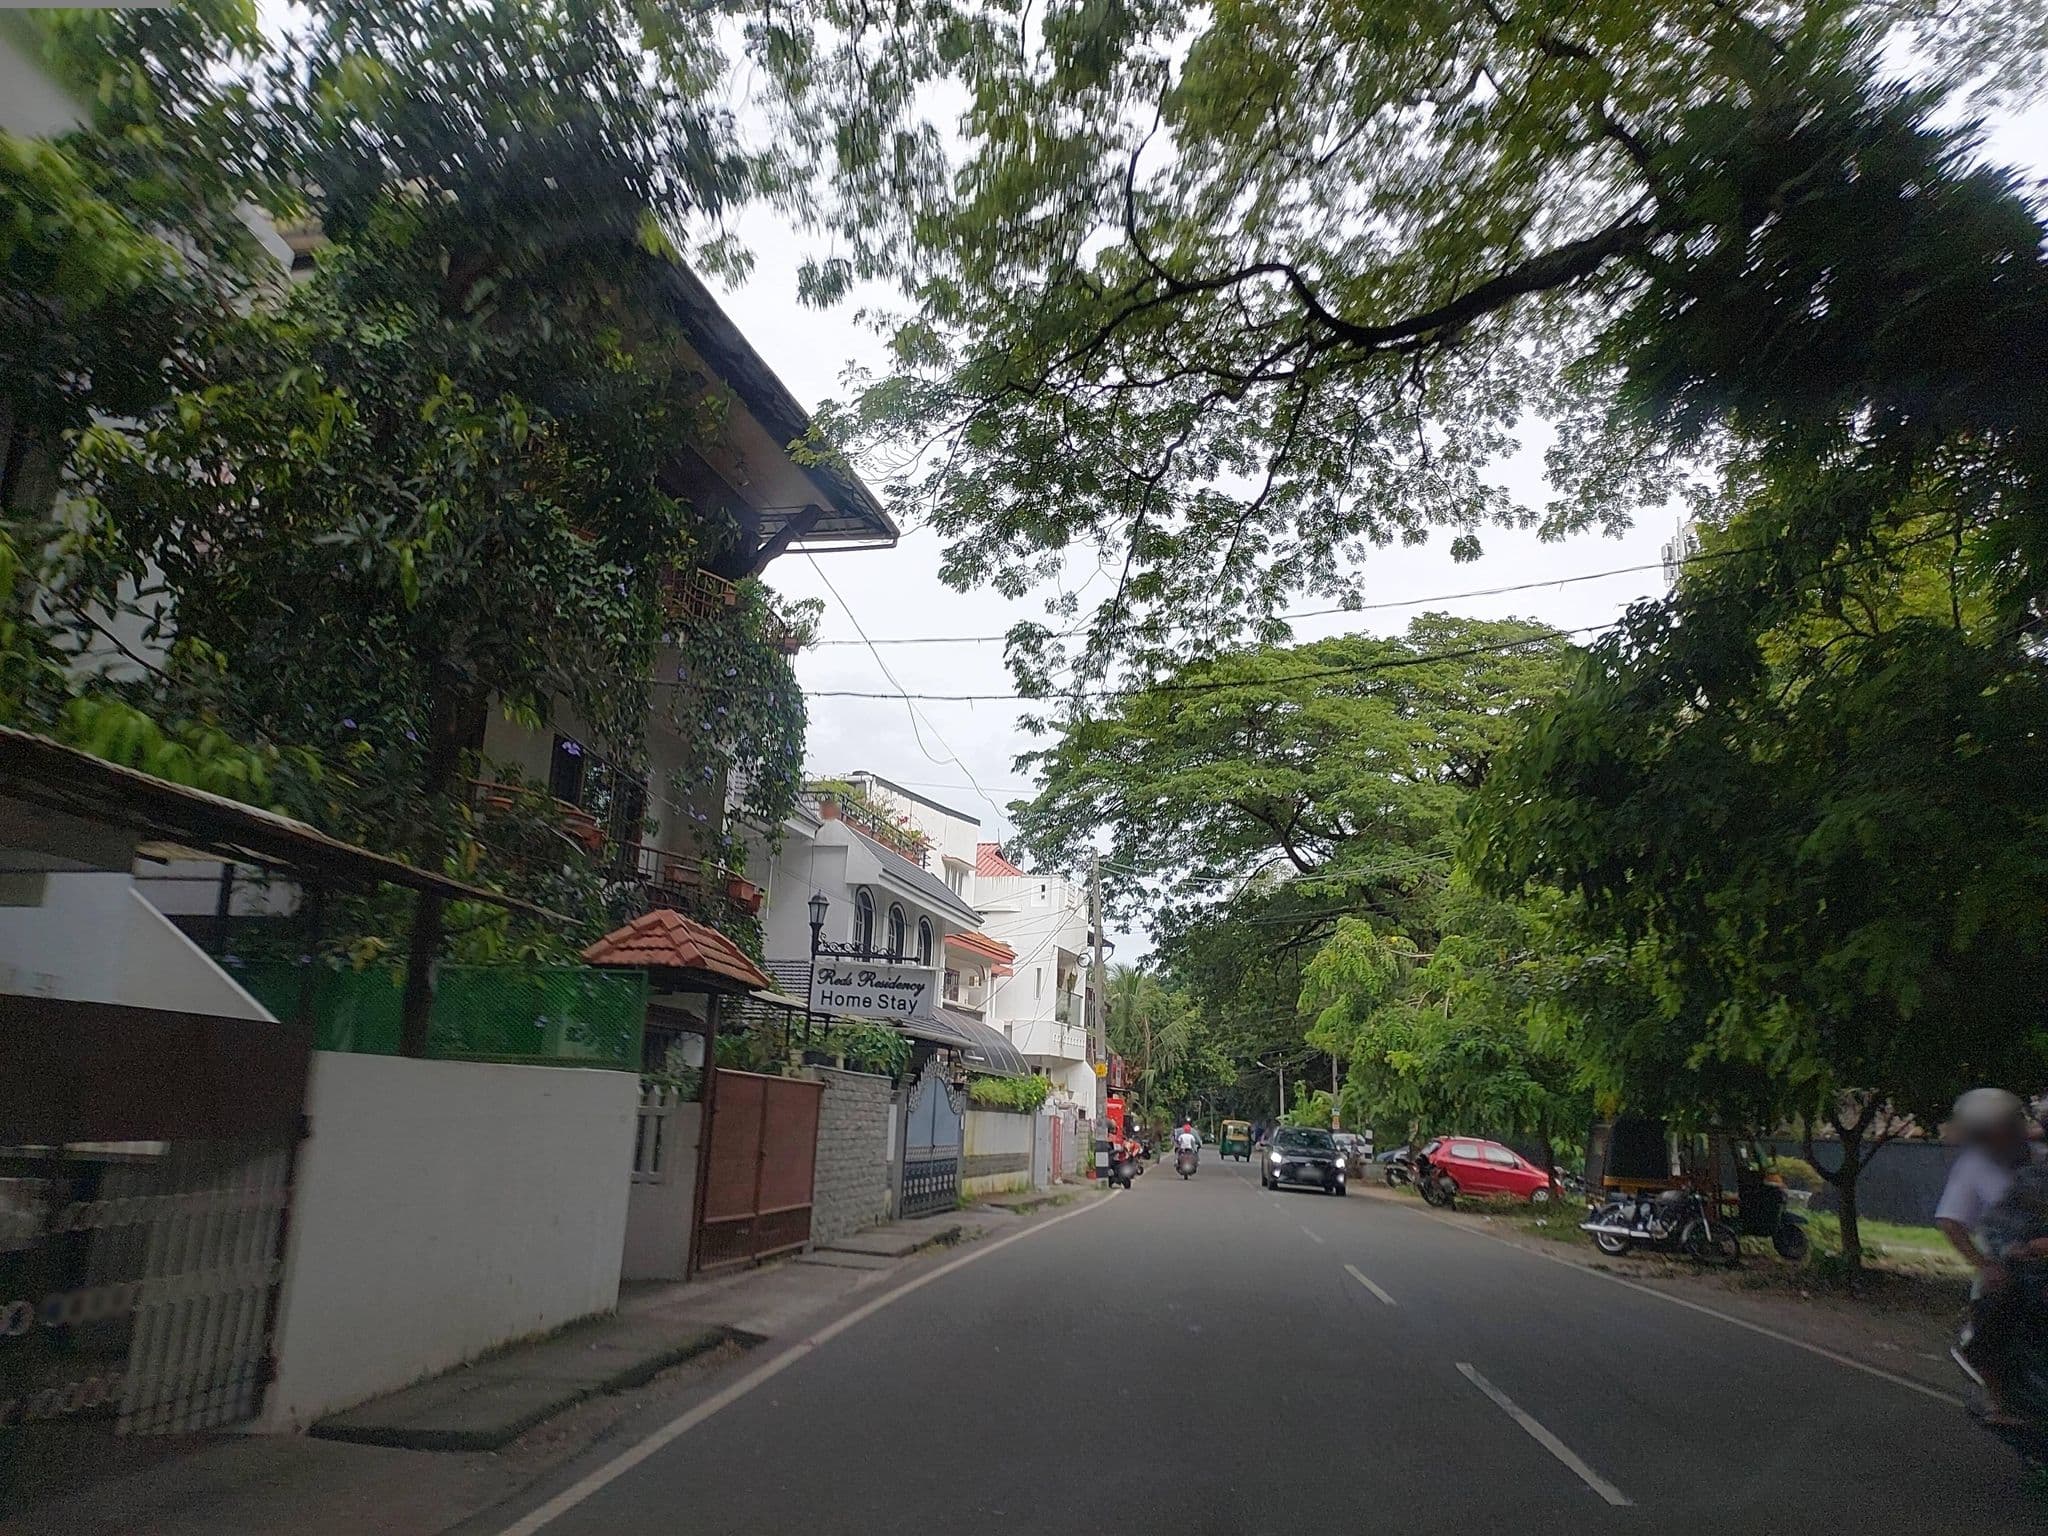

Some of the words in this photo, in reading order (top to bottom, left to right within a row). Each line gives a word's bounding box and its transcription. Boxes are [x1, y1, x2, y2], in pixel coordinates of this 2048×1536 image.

[817, 968, 853, 986] Reds
[857, 970, 926, 997] Residency
[820, 990, 872, 1008] Home
[877, 994, 918, 1015] Stay
